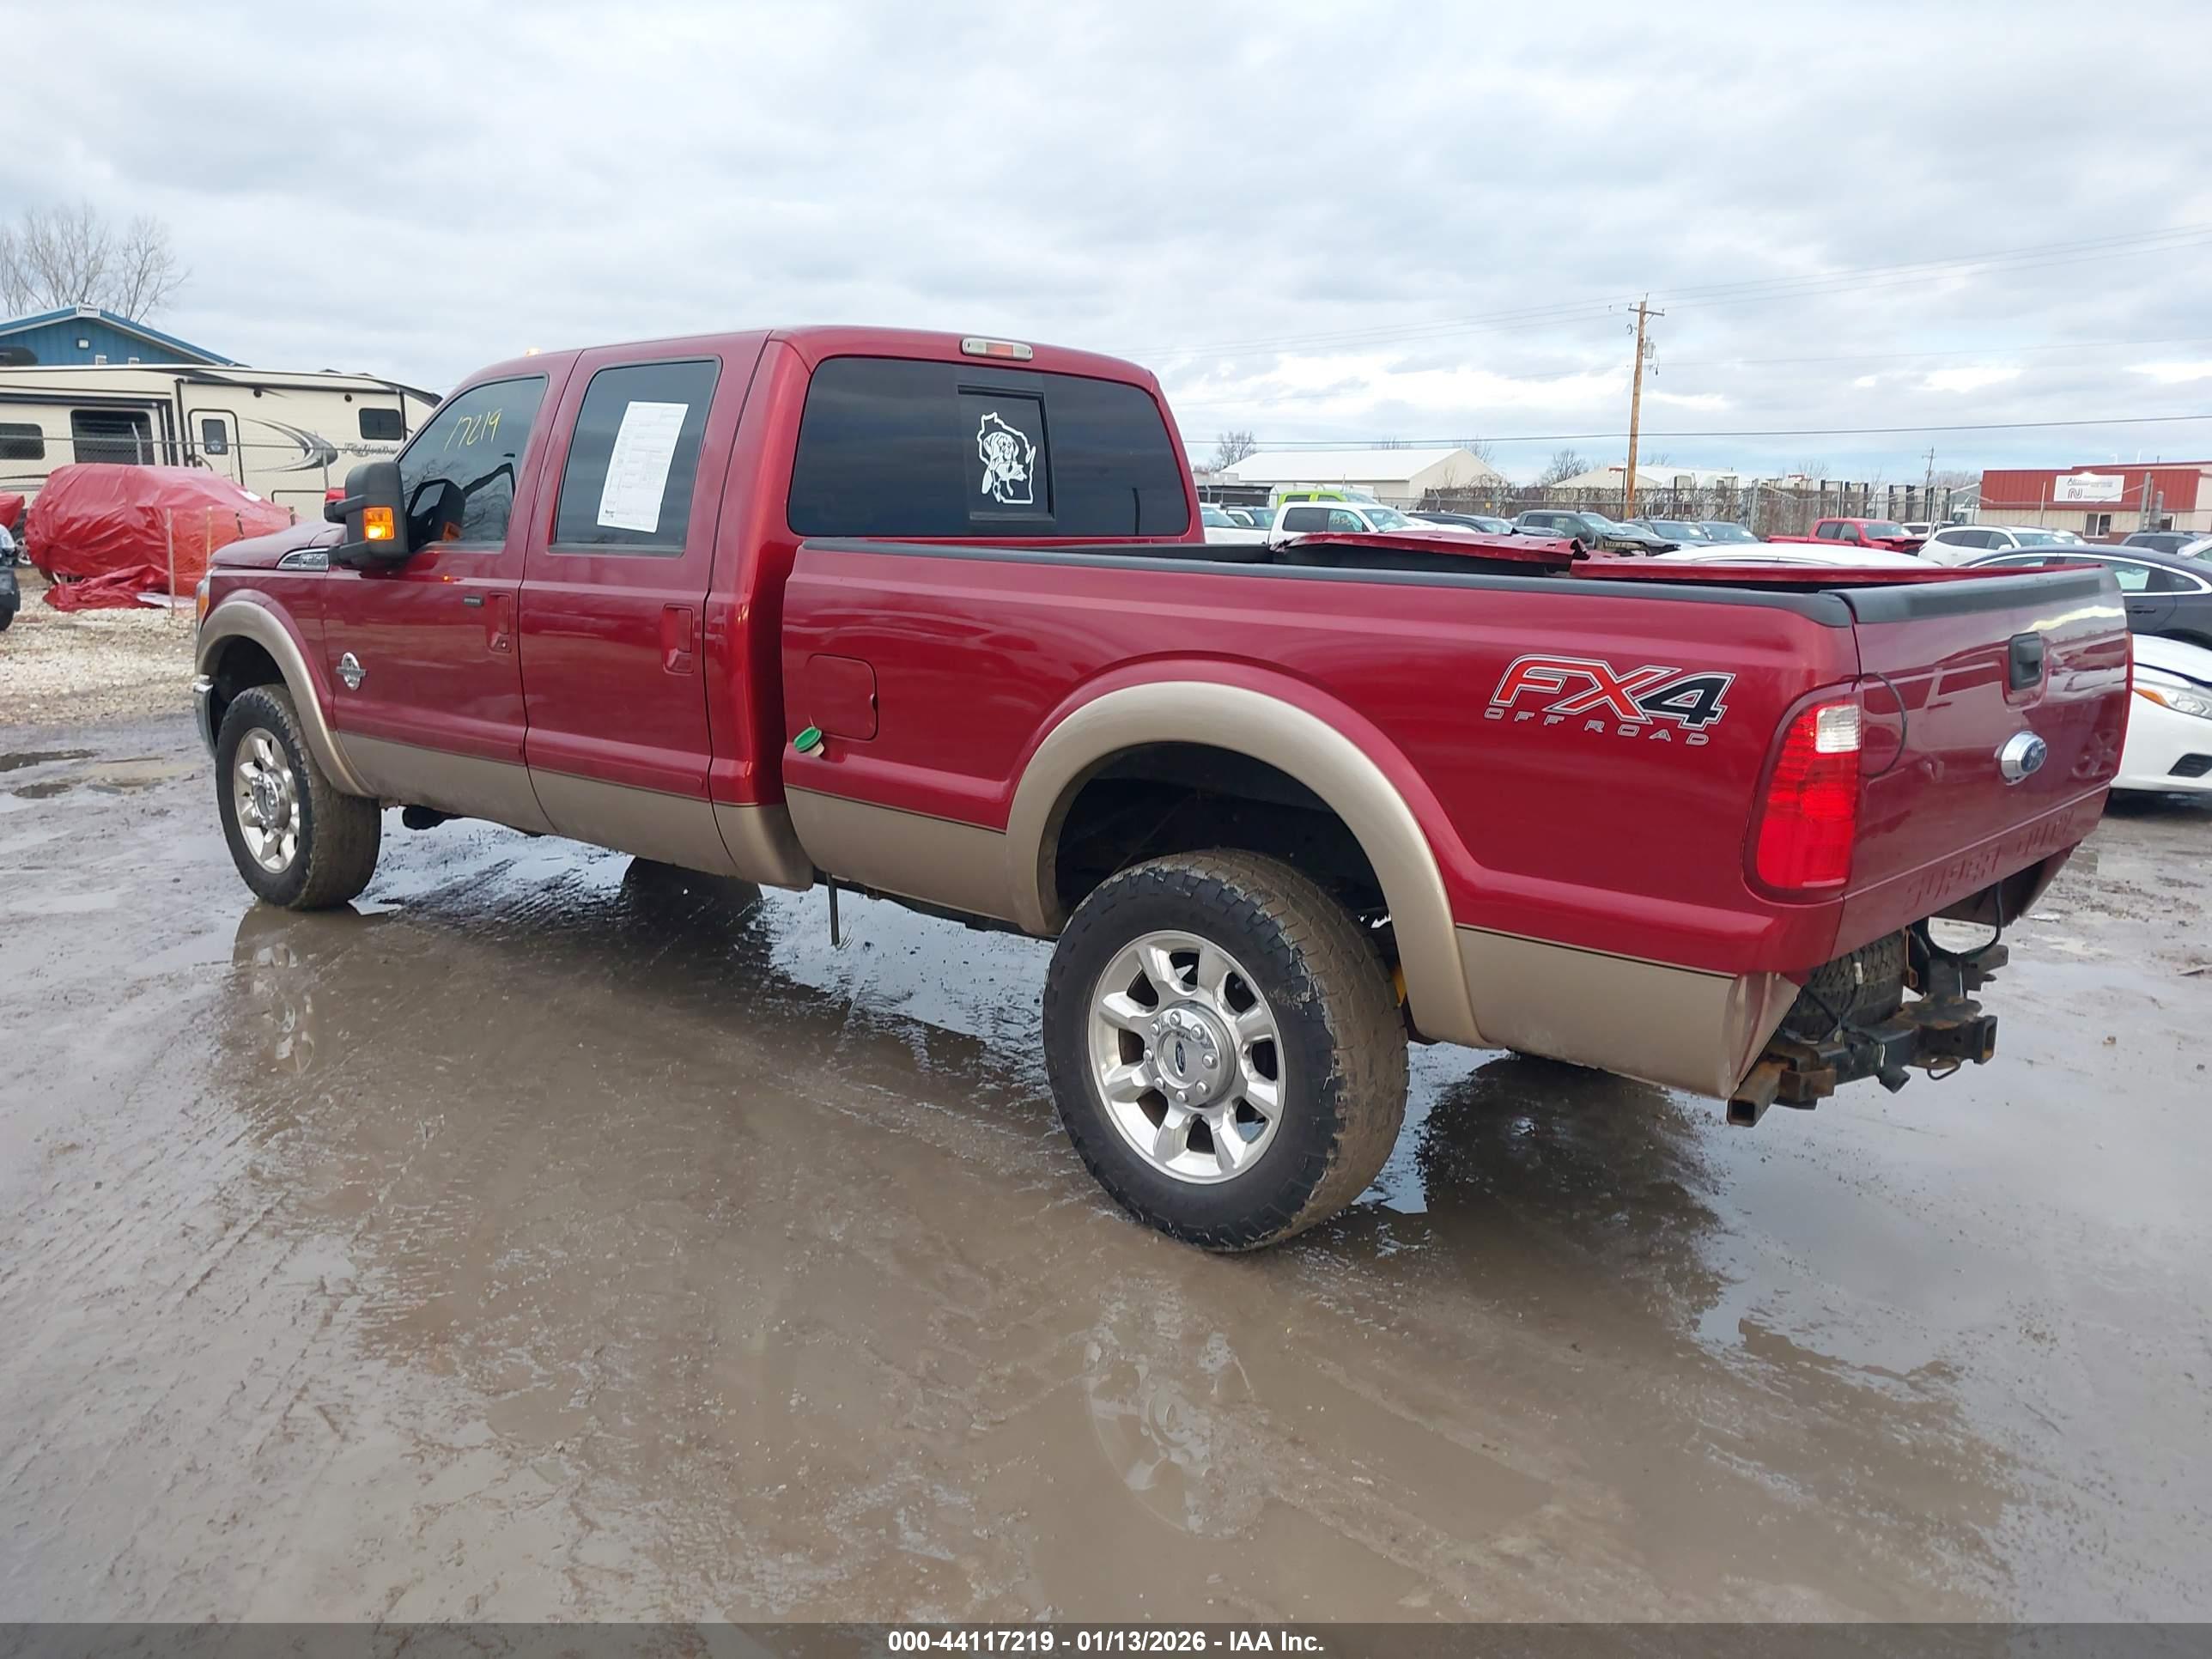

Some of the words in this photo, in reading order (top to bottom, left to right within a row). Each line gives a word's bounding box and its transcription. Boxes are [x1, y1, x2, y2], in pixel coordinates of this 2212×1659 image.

[443, 408, 502, 453] 17219
[1489, 653, 1736, 731] FX4
[1484, 708, 1565, 726] OFF
[1584, 720, 1710, 746] ROAD
